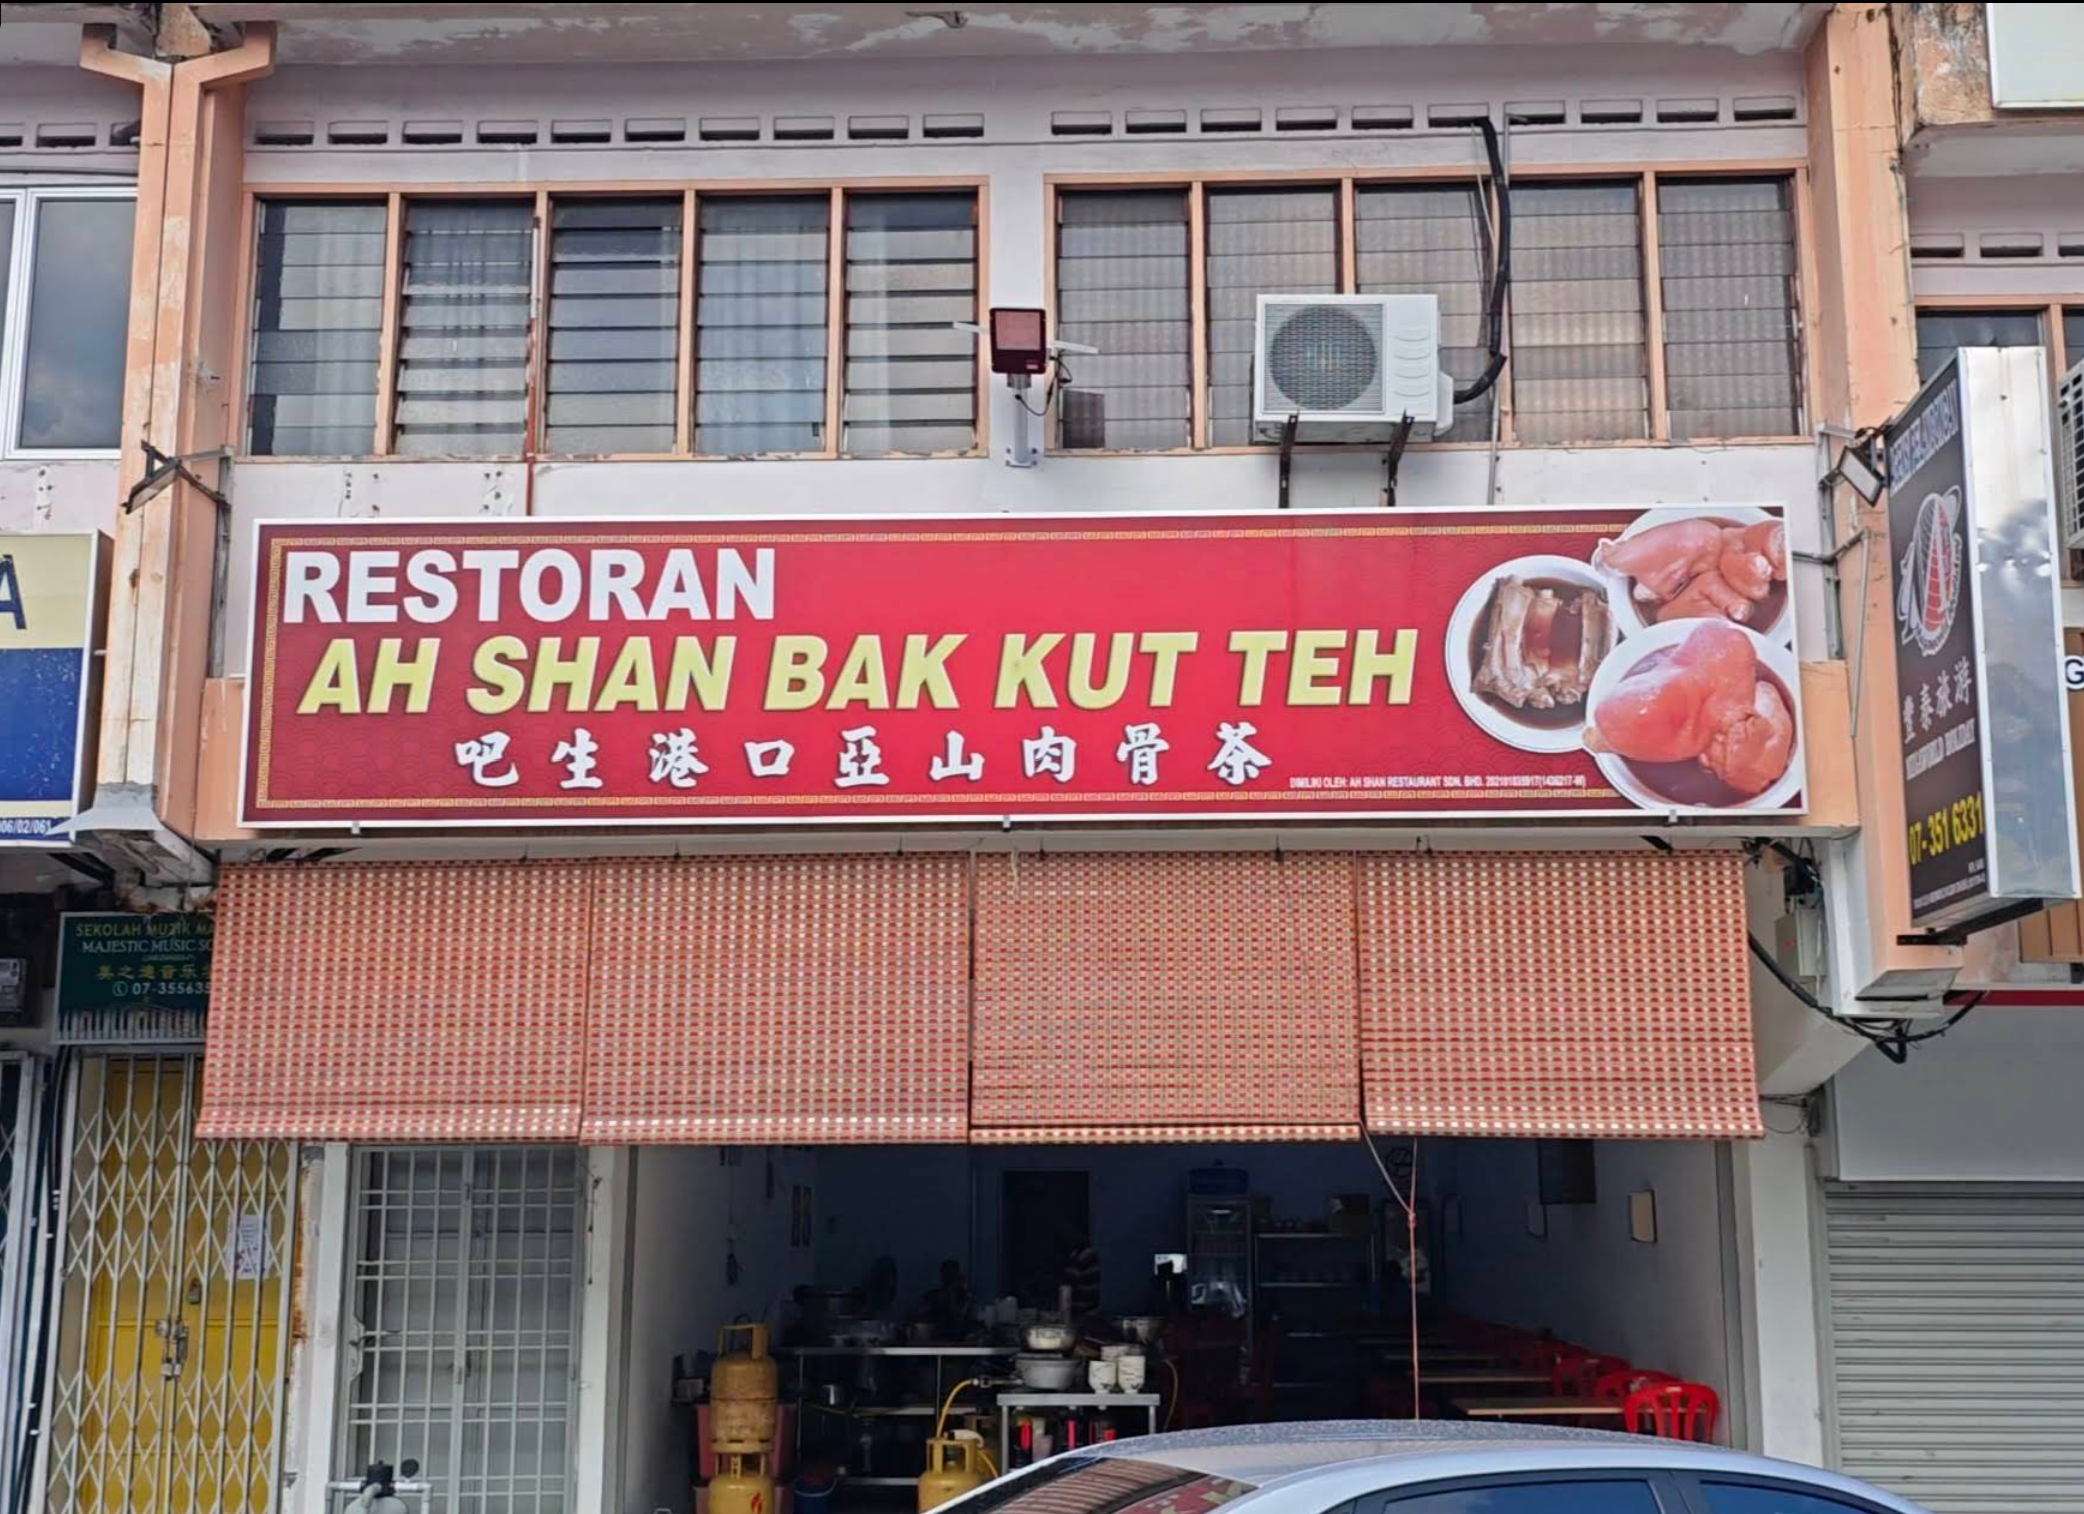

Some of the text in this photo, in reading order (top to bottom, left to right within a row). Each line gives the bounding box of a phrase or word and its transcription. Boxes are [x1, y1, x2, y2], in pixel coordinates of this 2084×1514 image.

[283, 548, 775, 624] RESTORAN
[296, 628, 1419, 714] AH SHAN BAK KUT TEH
[454, 722, 1272, 789] 吧生港口亞山肉骨茶
[1349, 776, 1362, 787] AH
[1363, 776, 1386, 787] SHAN
[1387, 776, 1442, 788] RESTAURANT
[76, 923, 141, 937] SEKOLAH
[146, 922, 190, 936] MUZIK
[82, 940, 149, 953] MAJESTIC
[151, 939, 196, 953] MUSIC
